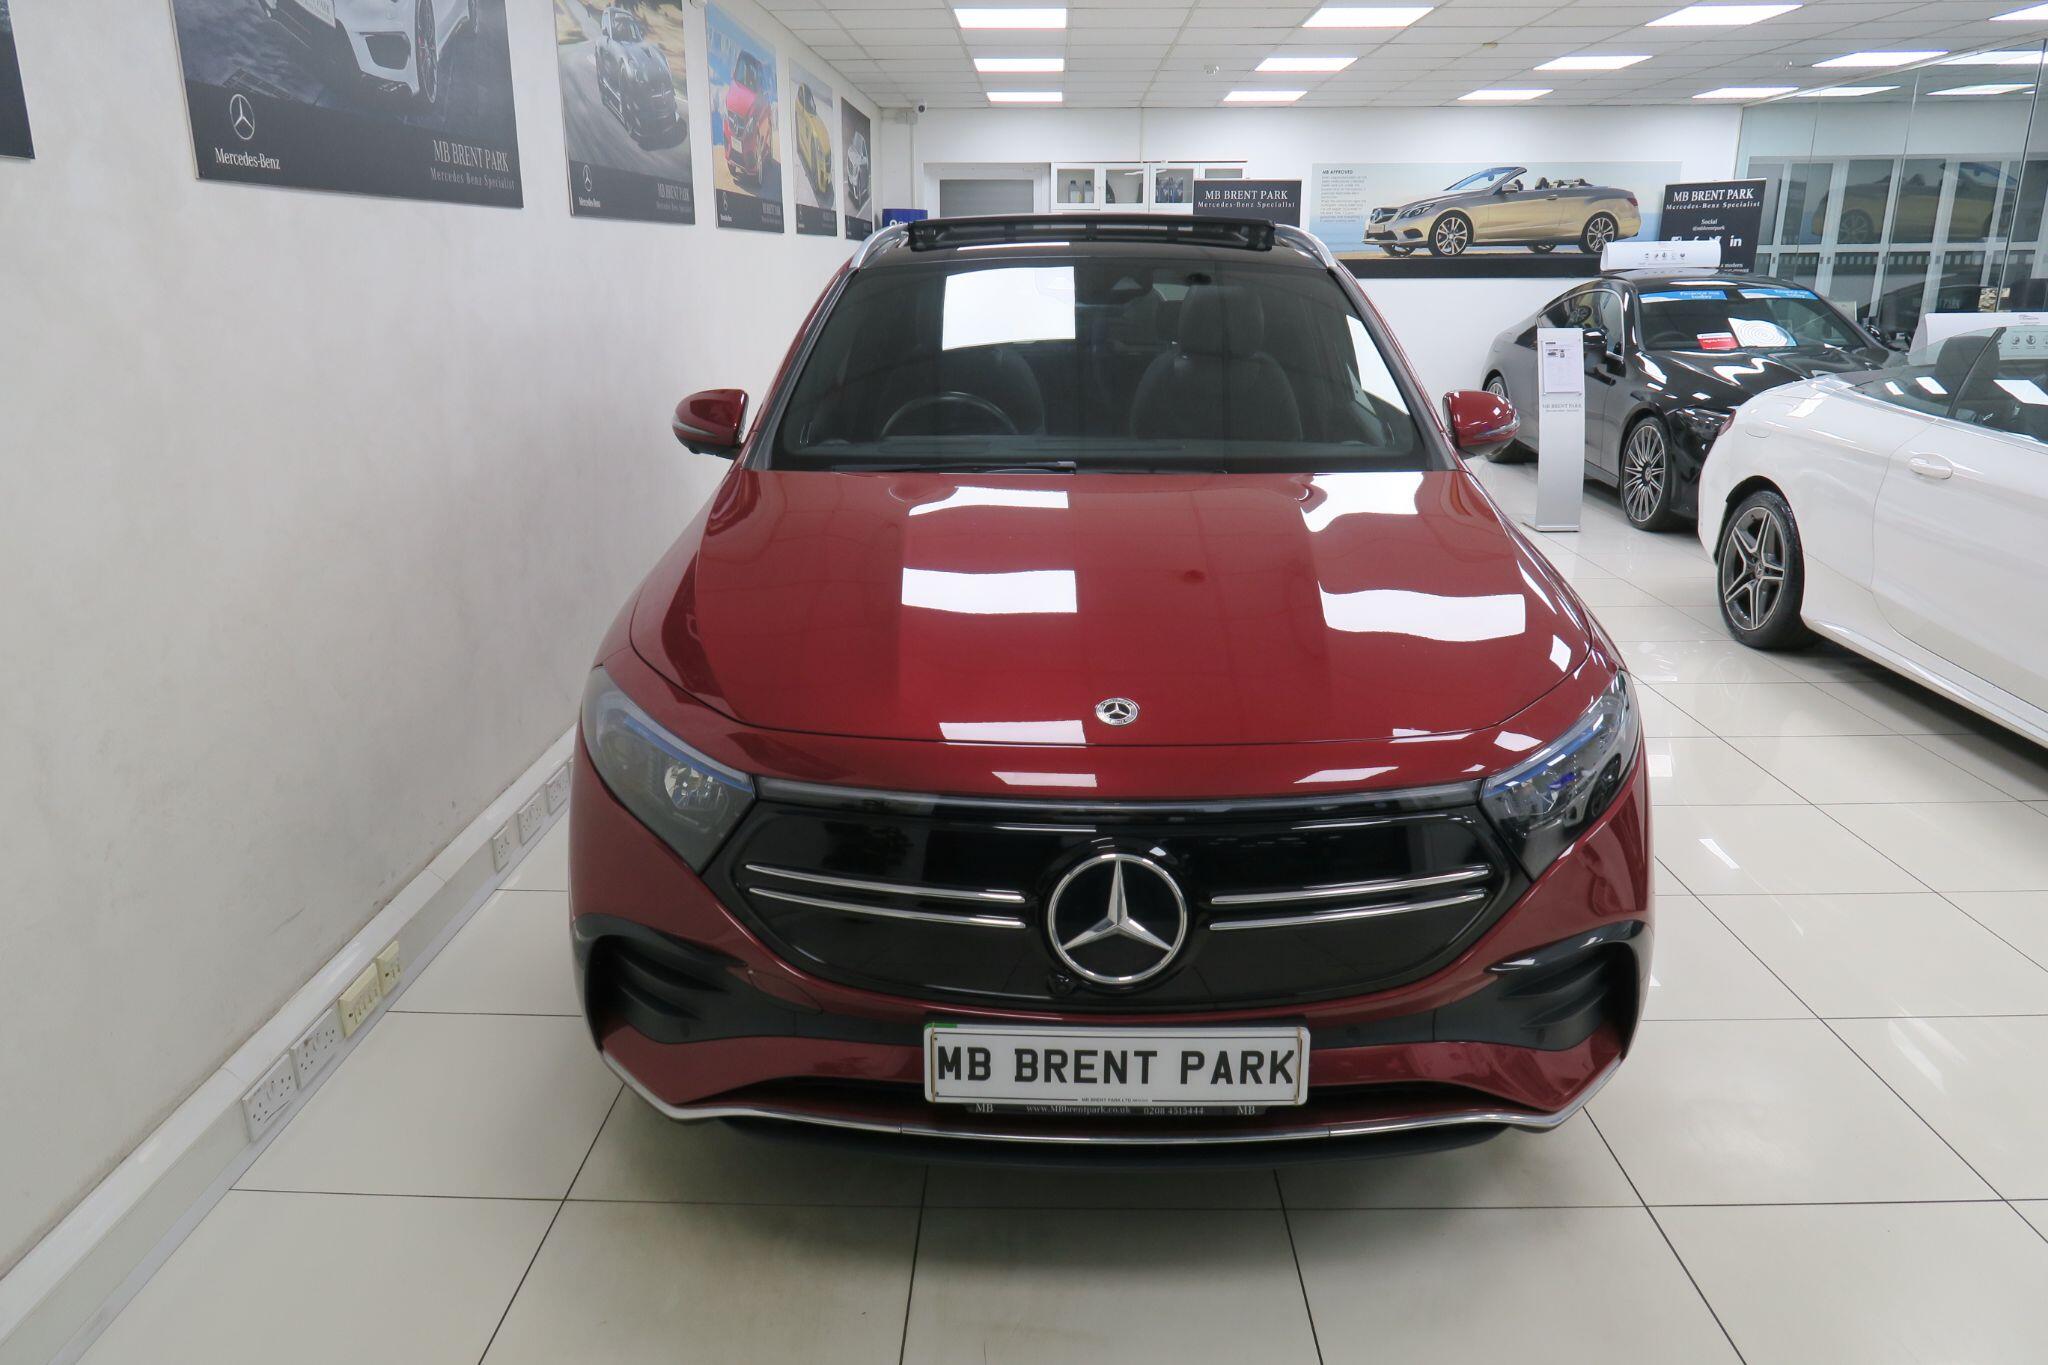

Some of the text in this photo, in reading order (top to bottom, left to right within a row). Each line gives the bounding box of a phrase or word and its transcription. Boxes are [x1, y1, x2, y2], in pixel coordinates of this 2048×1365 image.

[214, 147, 281, 170] Mercedes-Benz
[433, 139, 509, 172] MB BRENT PARK
[1204, 189, 1288, 200] MB BRENT PARK
[1673, 188, 1754, 202] MB BRENT PARK
[1665, 201, 1760, 210] Mercedes-Benz Specialist
[938, 1046, 1295, 1085] MB BRENT PARK
[975, 1103, 993, 1113] MB
[1237, 1105, 1255, 1115] MB
